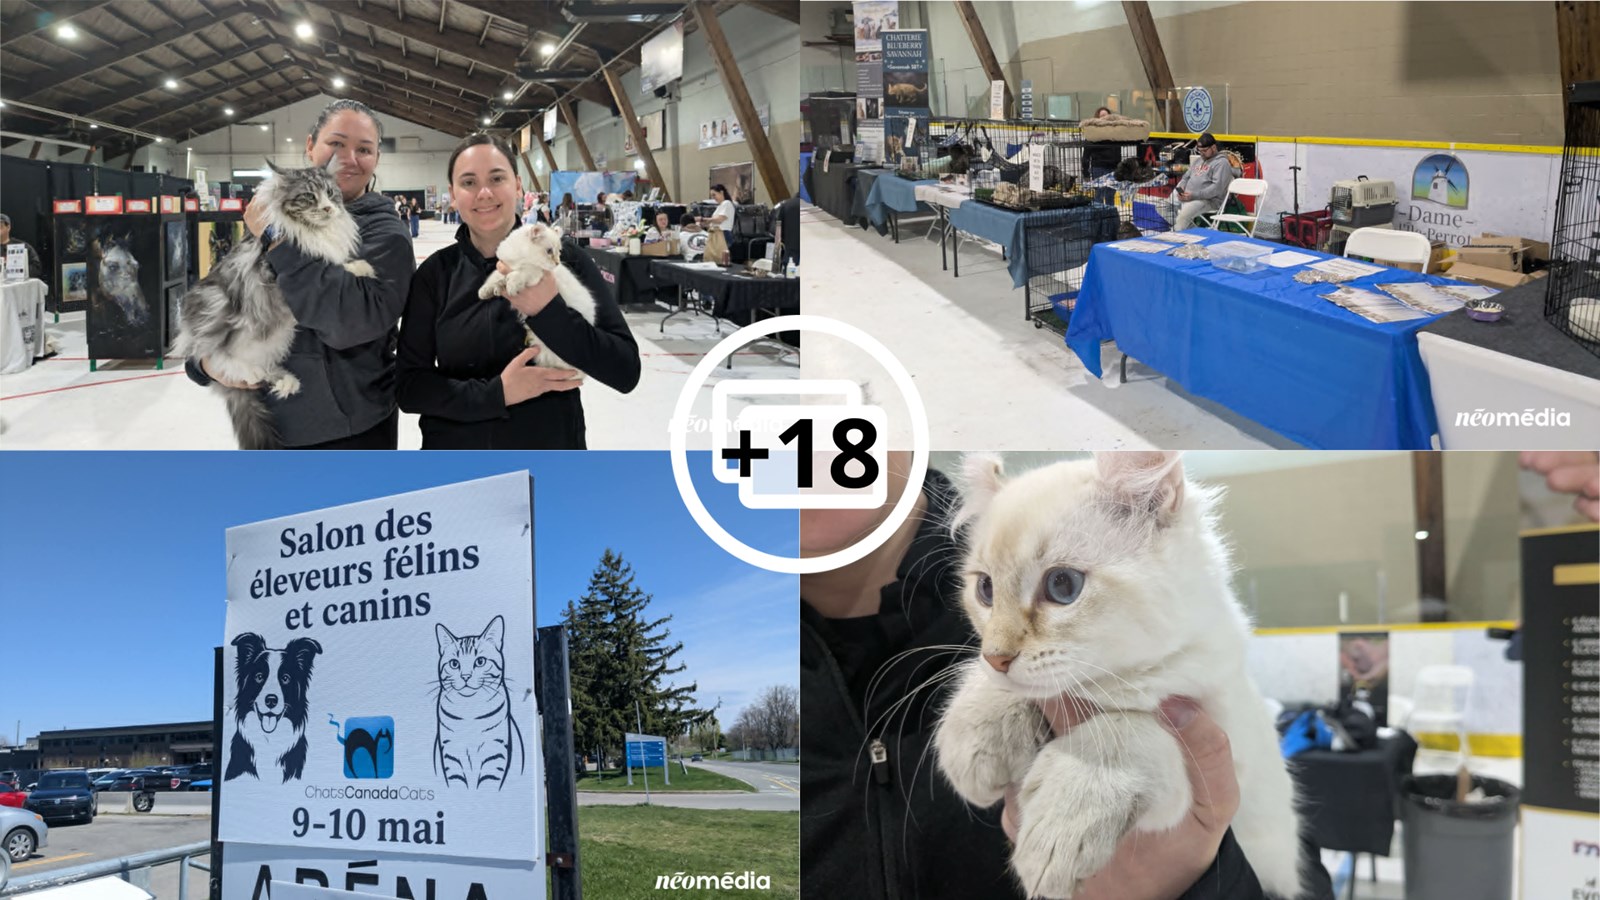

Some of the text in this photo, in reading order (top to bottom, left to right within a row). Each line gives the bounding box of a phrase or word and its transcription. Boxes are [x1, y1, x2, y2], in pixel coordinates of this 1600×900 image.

[280, 508, 433, 558] Salon des
[250, 542, 480, 599] éleveurs félins
[285, 588, 431, 630] et canins
[304, 785, 435, 801] ChatsCanadaCats
[292, 806, 447, 845] 9-10 mai
